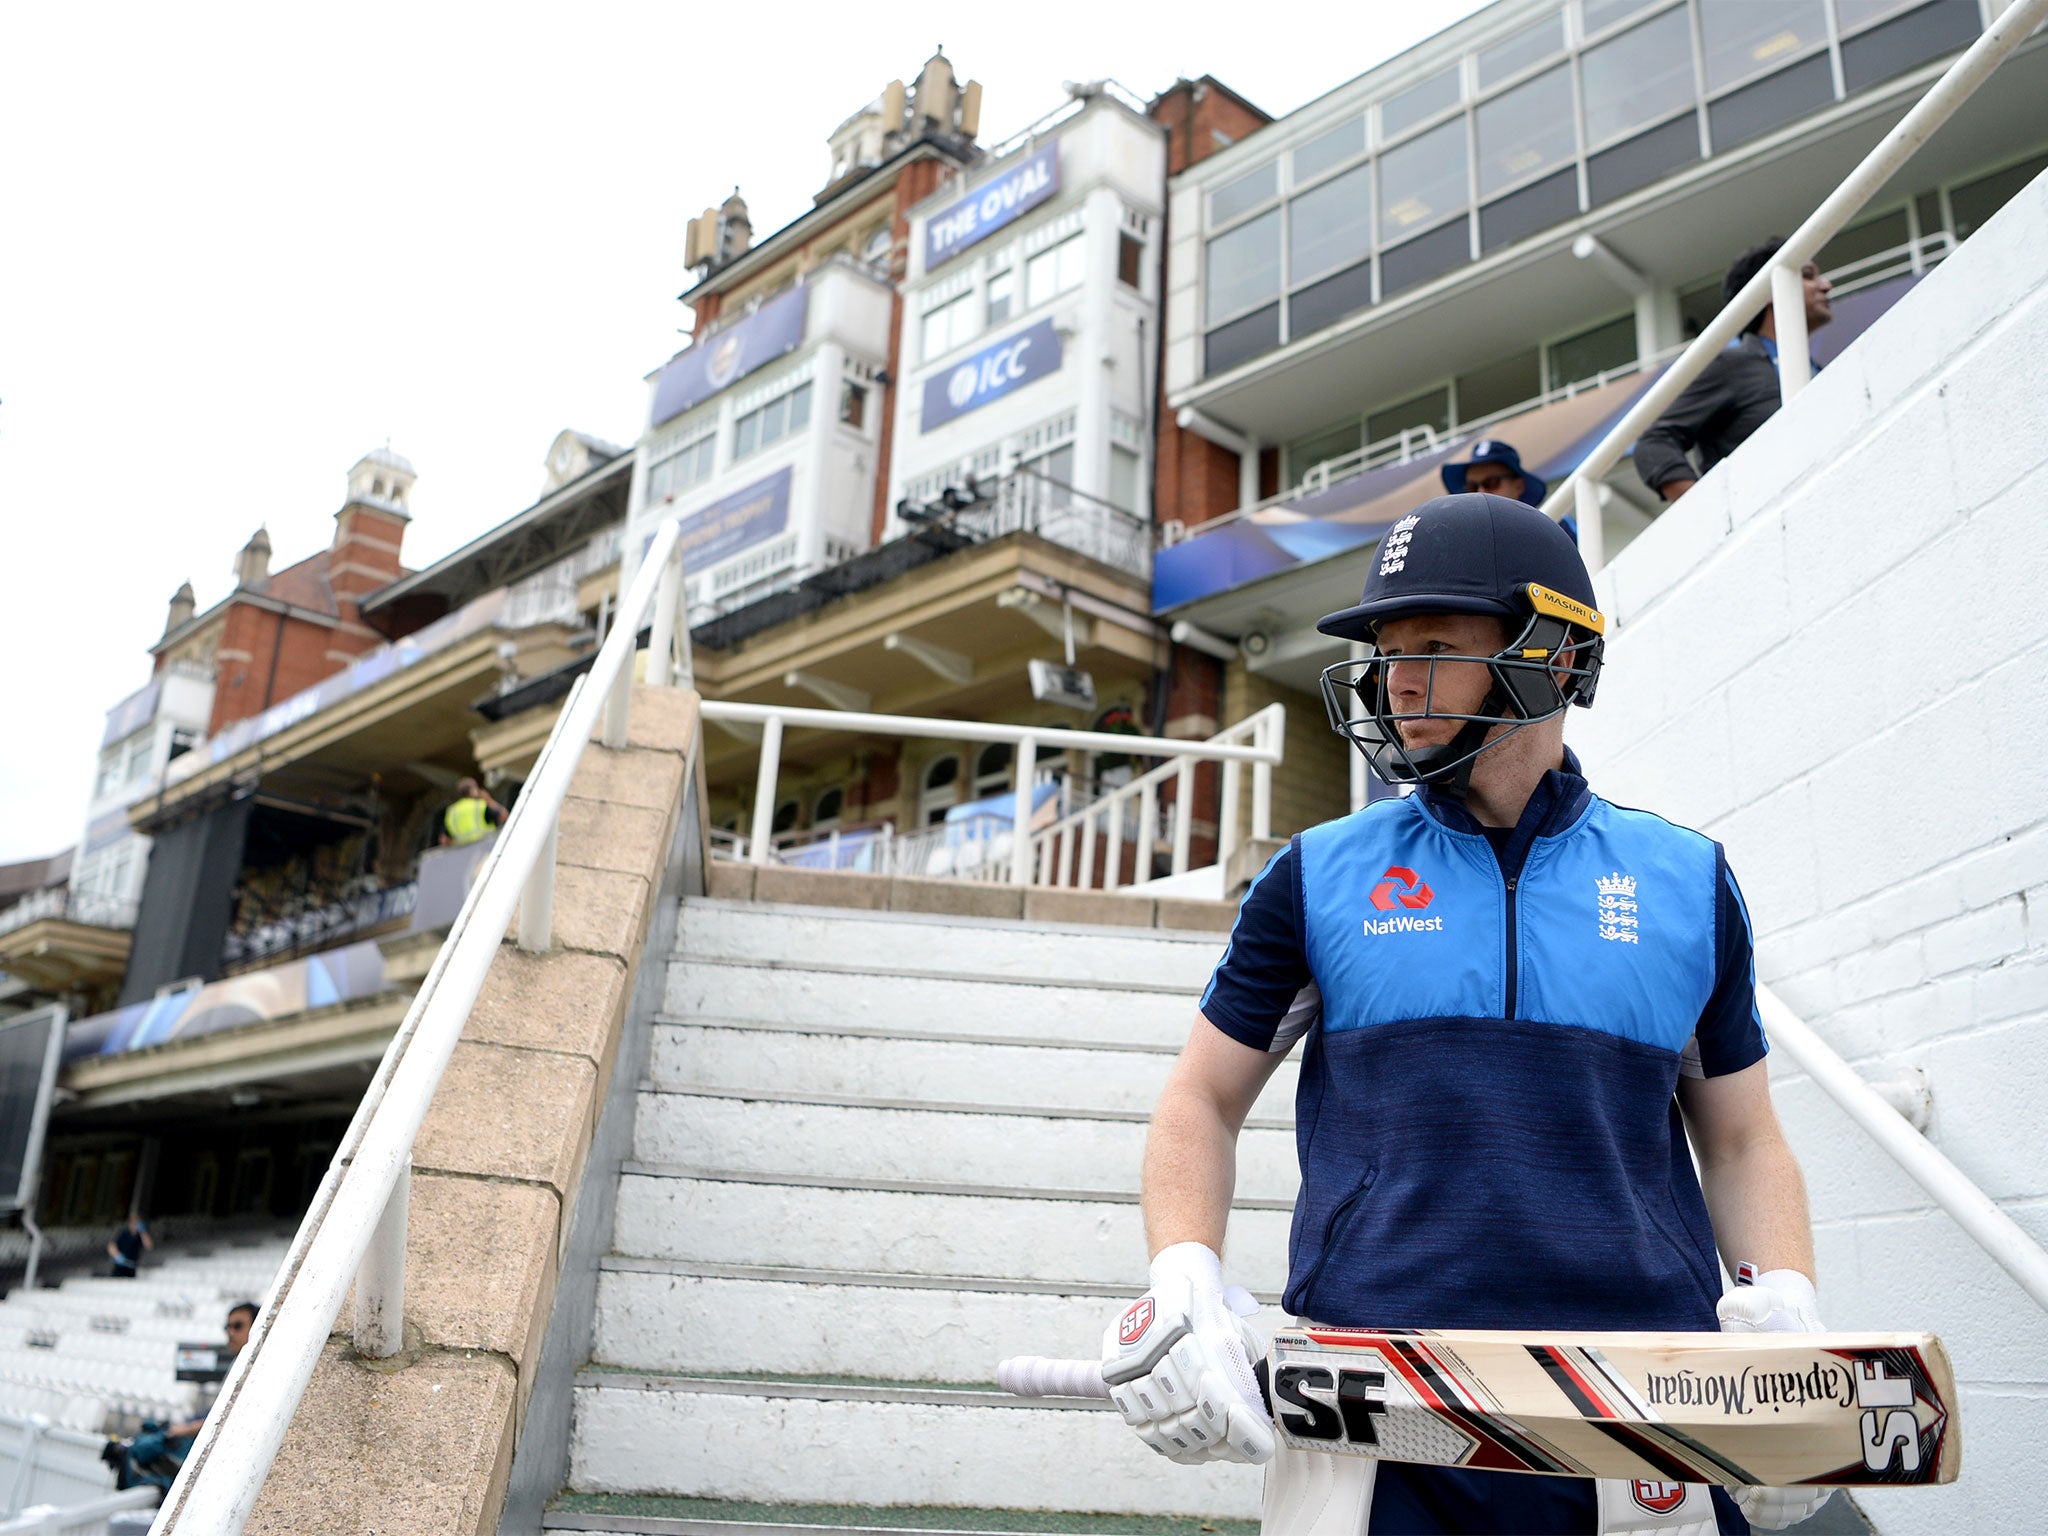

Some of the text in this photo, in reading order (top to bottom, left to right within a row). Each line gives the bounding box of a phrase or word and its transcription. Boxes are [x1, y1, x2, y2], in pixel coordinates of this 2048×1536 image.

[931, 159, 1050, 252] THE OVAL
[979, 337, 1031, 394] ICC
[1544, 593, 1586, 617] MASURI
[1363, 916, 1443, 936] NatWest
[1121, 1302, 1150, 1339] SF
[1274, 1337, 1308, 1346] STANFORD
[1274, 1362, 1387, 1446] SF
[1647, 1361, 1855, 1415] Captain Morgan
[1854, 1359, 1921, 1472] SF
